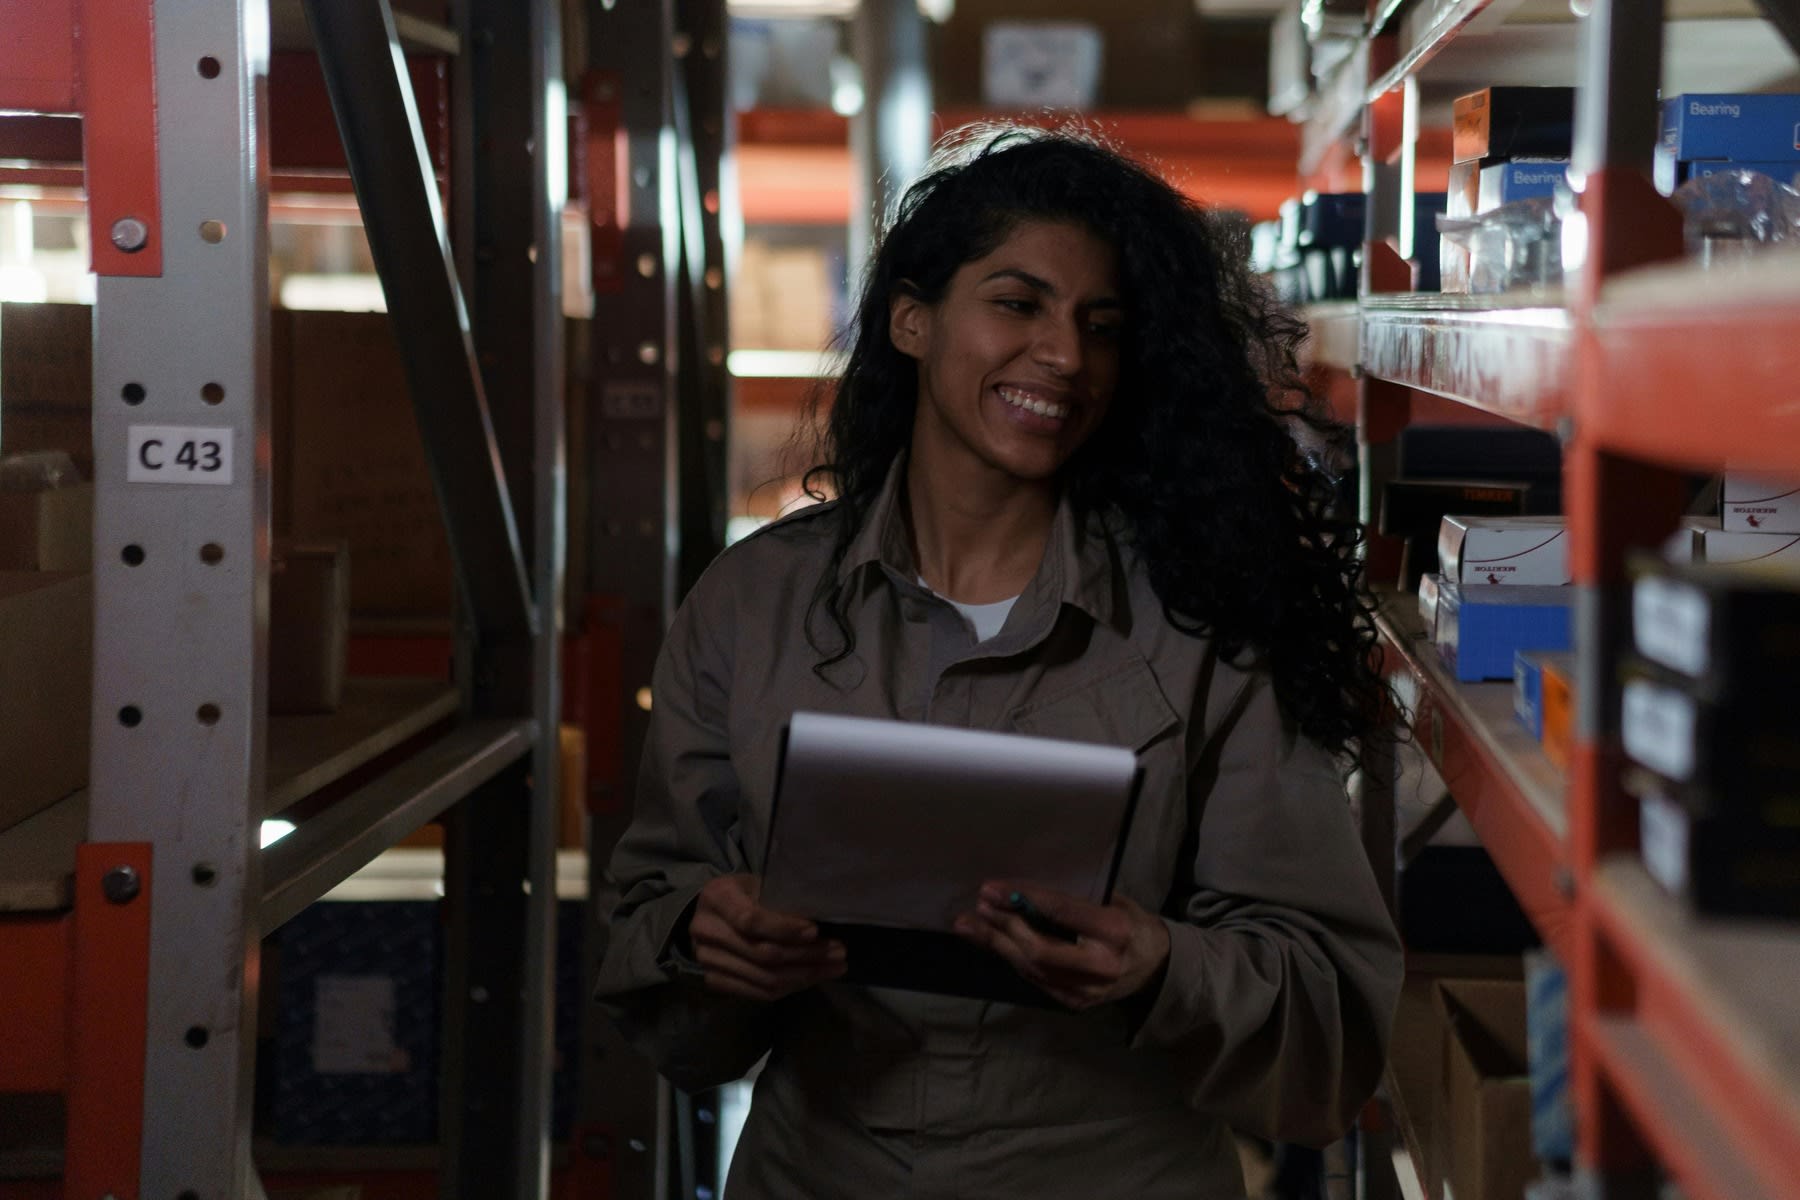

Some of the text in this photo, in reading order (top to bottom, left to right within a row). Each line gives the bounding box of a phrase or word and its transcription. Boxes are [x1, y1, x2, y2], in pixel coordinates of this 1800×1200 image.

[1689, 102, 1741, 118] Bearing
[140, 440, 222, 472] C 43
